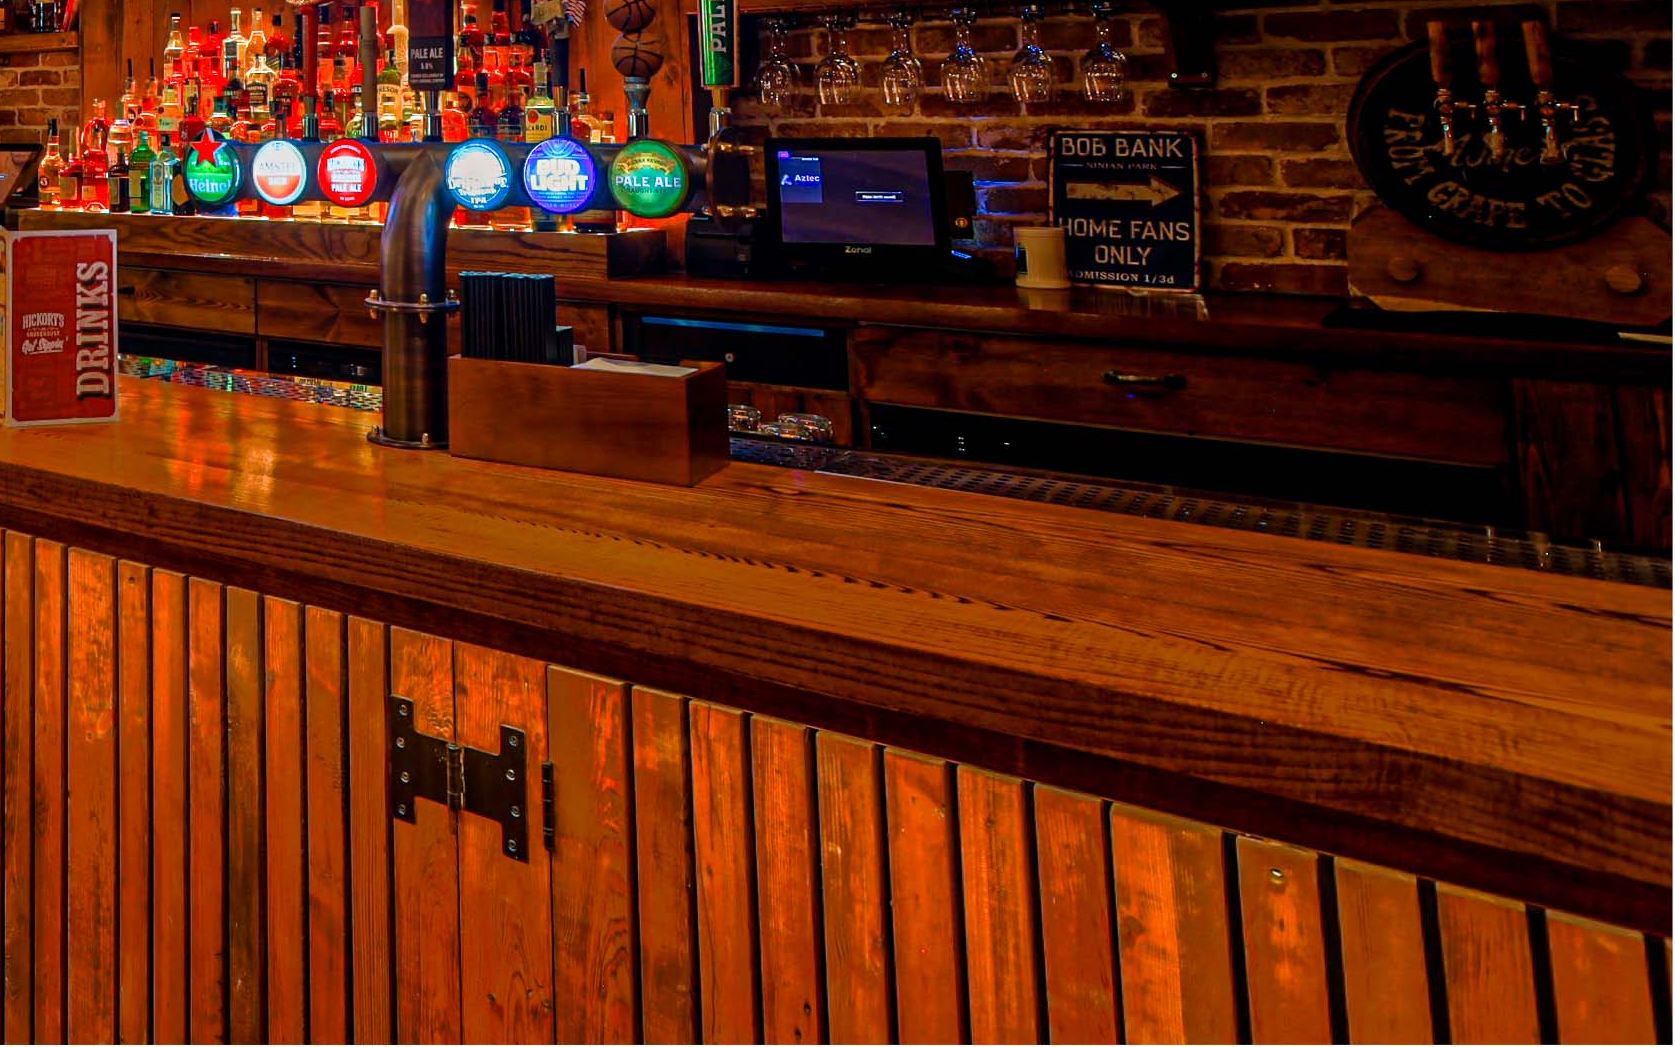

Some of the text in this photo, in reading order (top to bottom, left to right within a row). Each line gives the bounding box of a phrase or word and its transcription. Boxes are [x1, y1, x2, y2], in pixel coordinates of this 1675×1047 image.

[410, 47, 444, 60] PALE ALE
[1061, 137, 1184, 158] BOB BANK
[536, 159, 581, 175] BUD
[1085, 161, 1159, 170] NINIAN PARK
[1383, 93, 1615, 228] FROM GRAPE TO GLASS
[530, 174, 588, 191] LIGHT
[616, 175, 682, 188] PALE ALE
[794, 174, 820, 183] Aztec
[1059, 217, 1191, 242] HOME FANS
[1094, 244, 1152, 266] ONLY
[1143, 274, 1175, 284] 1/3d
[75, 260, 110, 397] DRINKS
